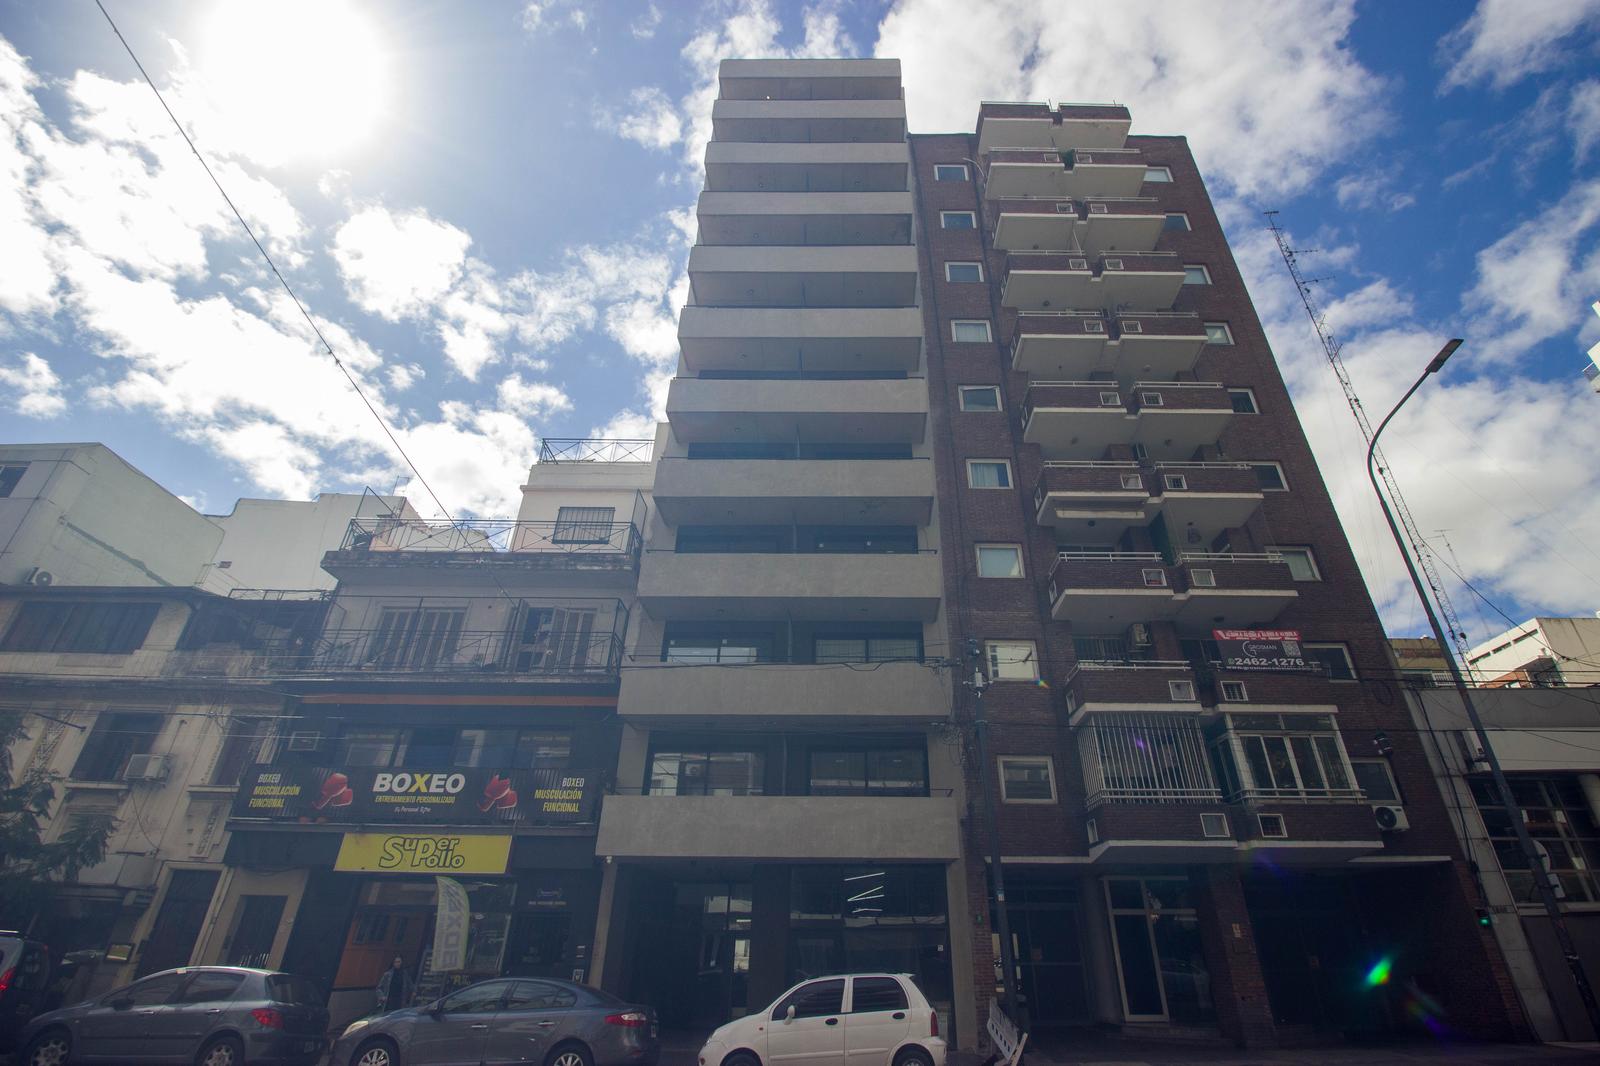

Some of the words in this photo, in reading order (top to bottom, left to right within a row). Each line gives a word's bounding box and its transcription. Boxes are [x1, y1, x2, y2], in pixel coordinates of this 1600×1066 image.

[1234, 657, 1305, 666] 2462-1276
[258, 774, 281, 783] BOXEO
[372, 773, 465, 793] BOXEO
[562, 777, 585, 787] BOXEO
[534, 788, 582, 799] MUSCULACIÓN
[543, 802, 579, 812] FUNCIONAL
